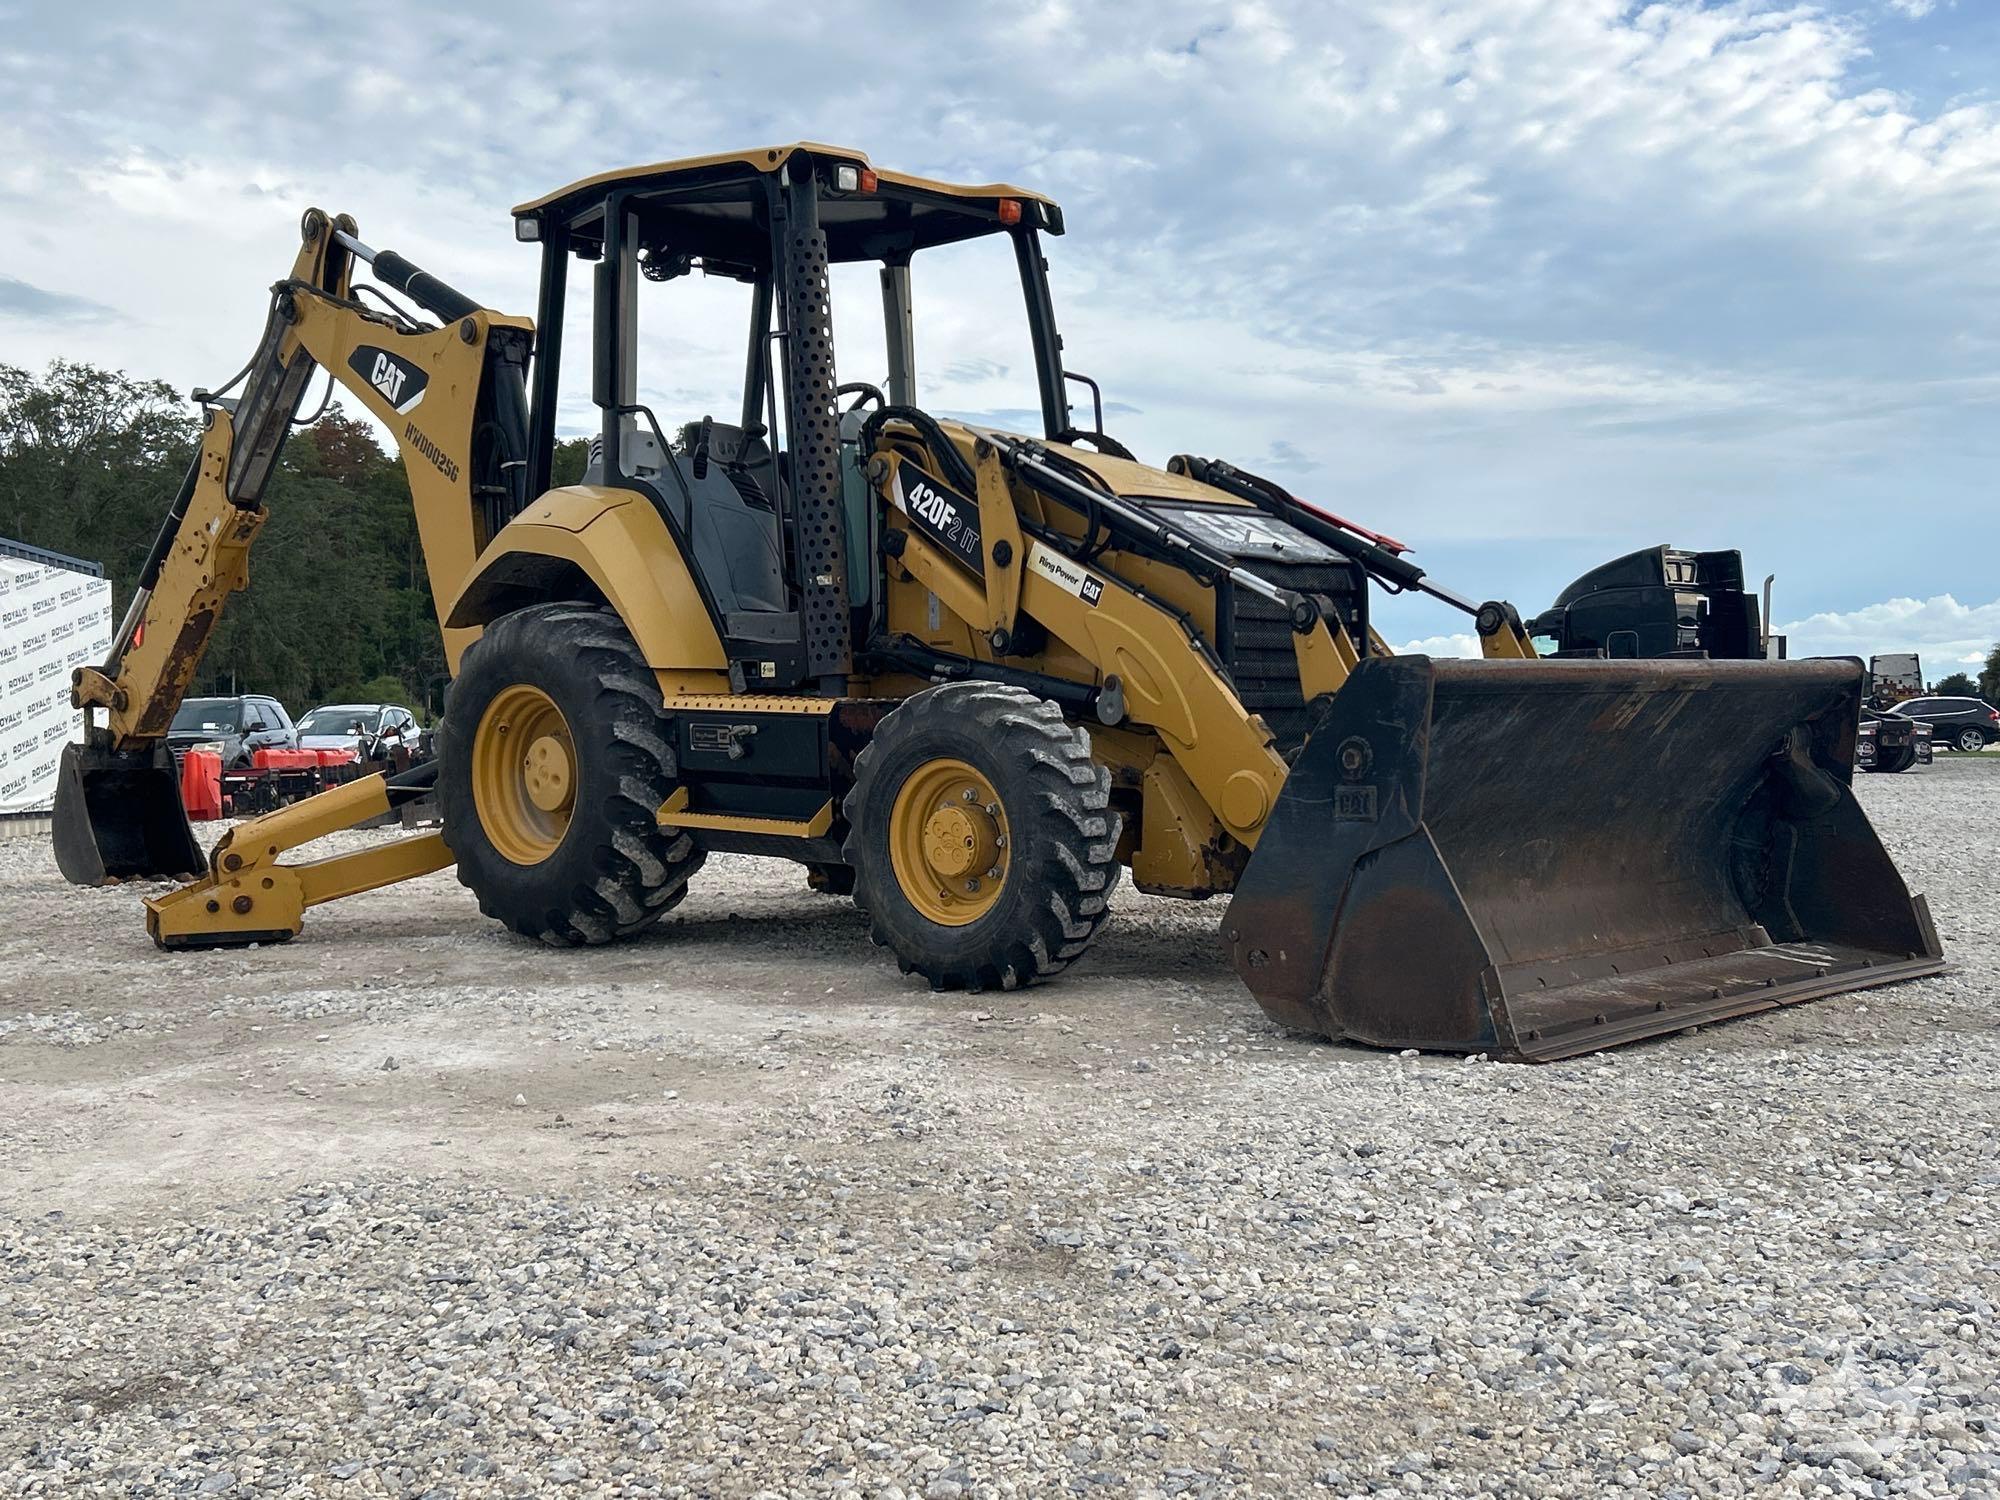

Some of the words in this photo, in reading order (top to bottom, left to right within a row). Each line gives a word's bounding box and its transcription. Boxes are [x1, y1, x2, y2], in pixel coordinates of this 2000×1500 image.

[371, 352, 407, 404] CAT
[1183, 511, 1301, 548] CAT
[959, 527, 980, 554] IT
[15, 571, 35, 583] ROYAL
[1039, 556, 1056, 573] Ring
[1055, 565, 1079, 585] Power
[60, 588, 78, 601] ROYAL
[1083, 581, 1101, 600] CAT
[33, 599, 51, 611] ROYAL
[2, 610, 22, 623] ROYAL
[78, 613, 95, 625] ROYAL
[51, 624, 69, 637] ROYAL
[23, 636, 41, 649] ROYAL
[92, 638, 108, 650] ROYAL
[67, 650, 84, 662] ROYAL
[39, 662, 58, 674] ROYAL
[8, 675, 28, 688] ROYAL
[27, 701, 46, 714] ROYAL
[44, 725, 62, 738] ROYAL
[13, 741, 32, 754] ROYAL
[32, 763, 50, 777] ROYAL
[1, 782, 20, 795] ROYAL
